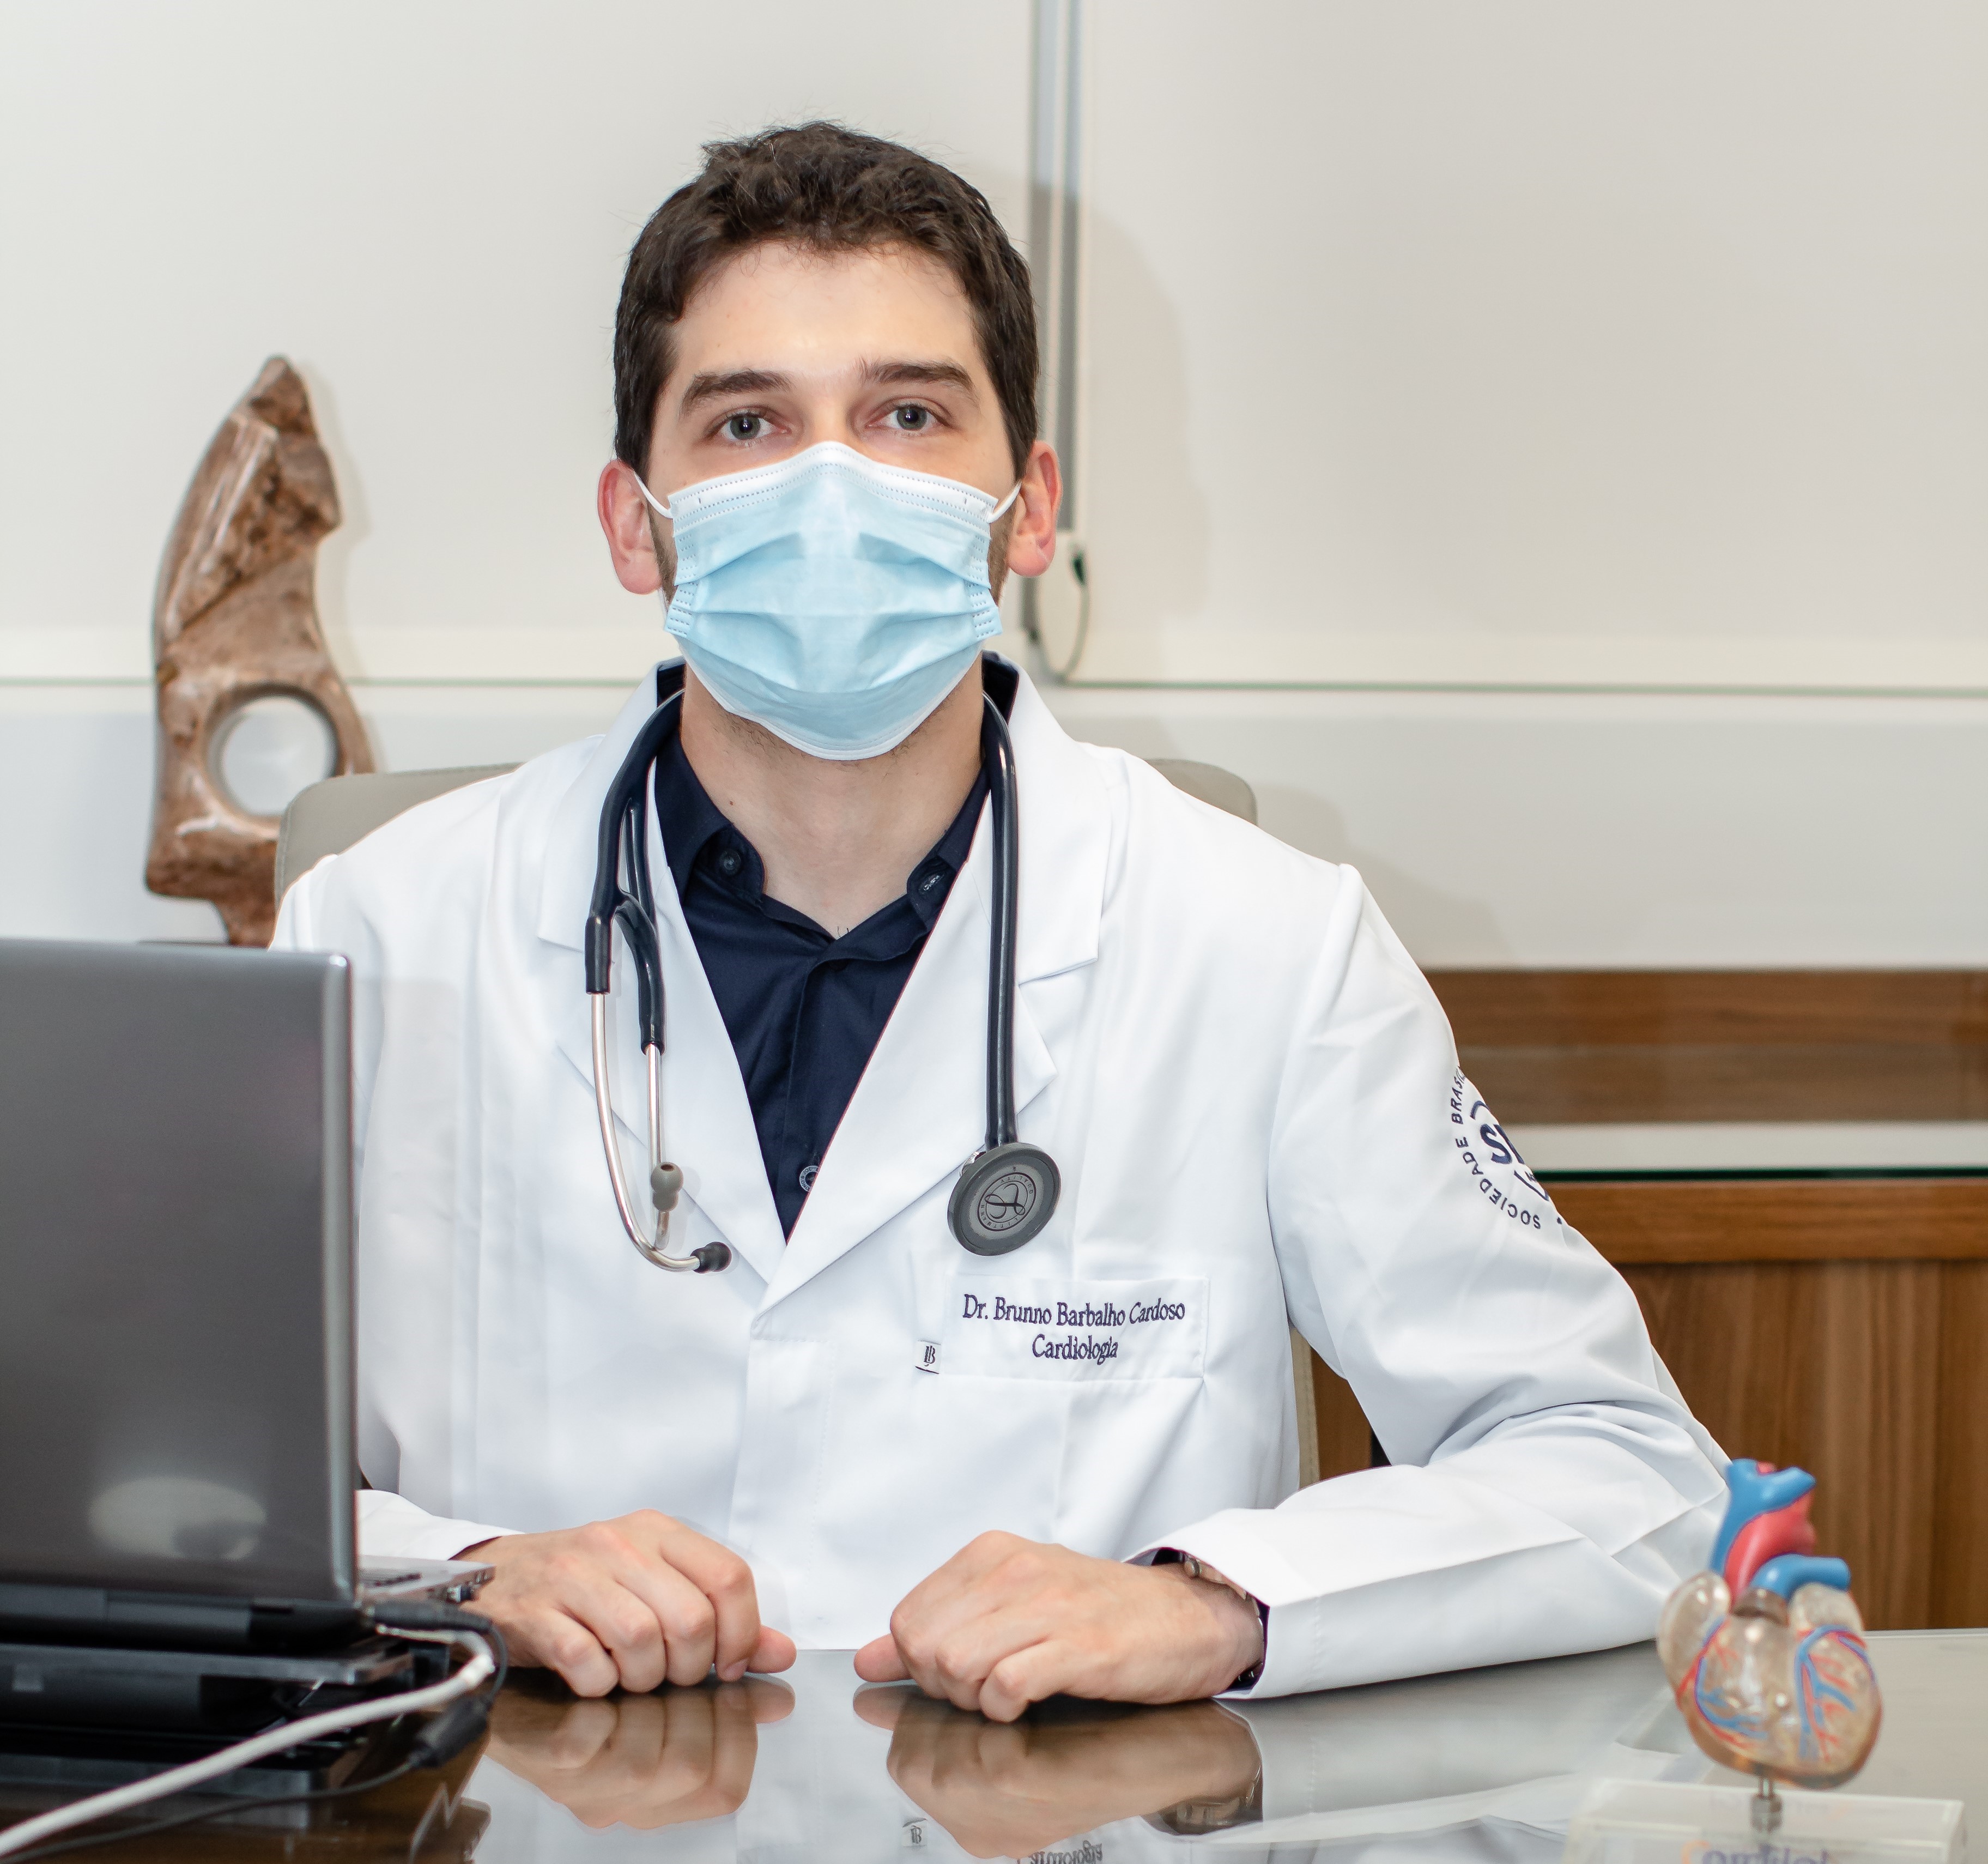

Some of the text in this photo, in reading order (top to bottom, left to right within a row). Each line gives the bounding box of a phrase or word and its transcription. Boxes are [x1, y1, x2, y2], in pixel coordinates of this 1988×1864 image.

[1451, 1066, 1541, 1230] SOCIEDADE BRASIL
[962, 1293, 1186, 1327] Dr. Brunno Barbalho Cardoso
[1032, 1333, 1119, 1365] Cardiologia
